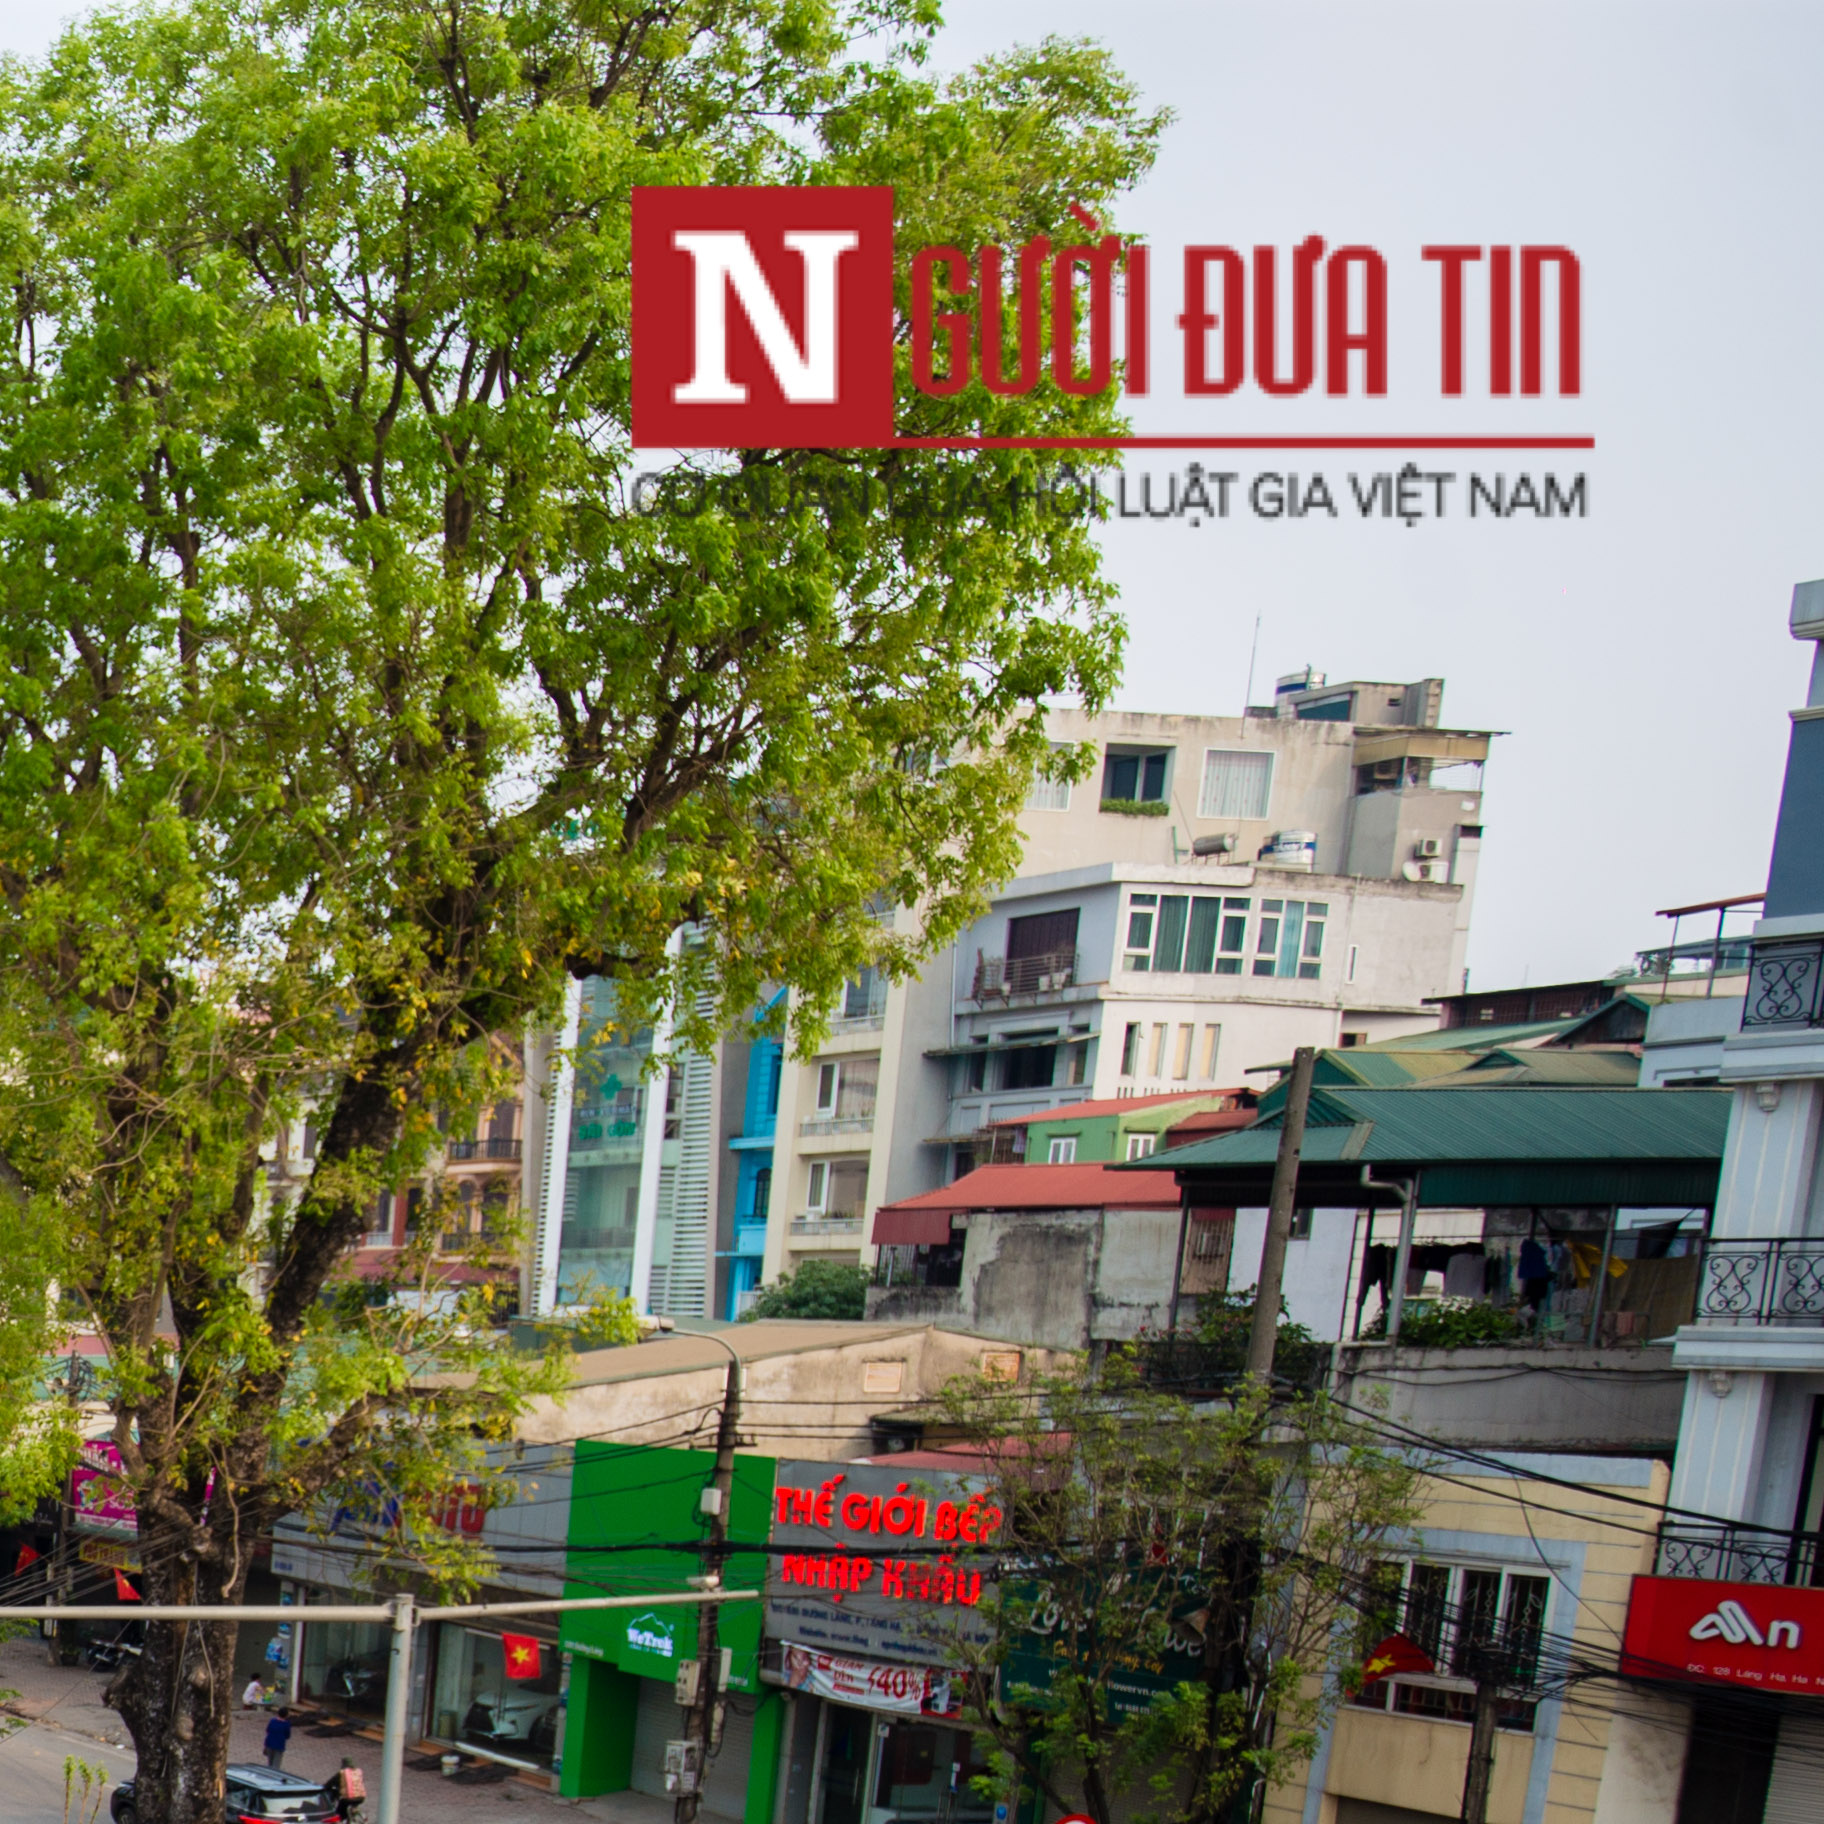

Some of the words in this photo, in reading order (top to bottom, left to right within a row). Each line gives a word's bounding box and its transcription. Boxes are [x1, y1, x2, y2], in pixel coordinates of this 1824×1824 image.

[775, 1473, 845, 1528] THẾ
[841, 1482, 928, 1538] GIỚI
[781, 1541, 873, 1603] NHẬP
